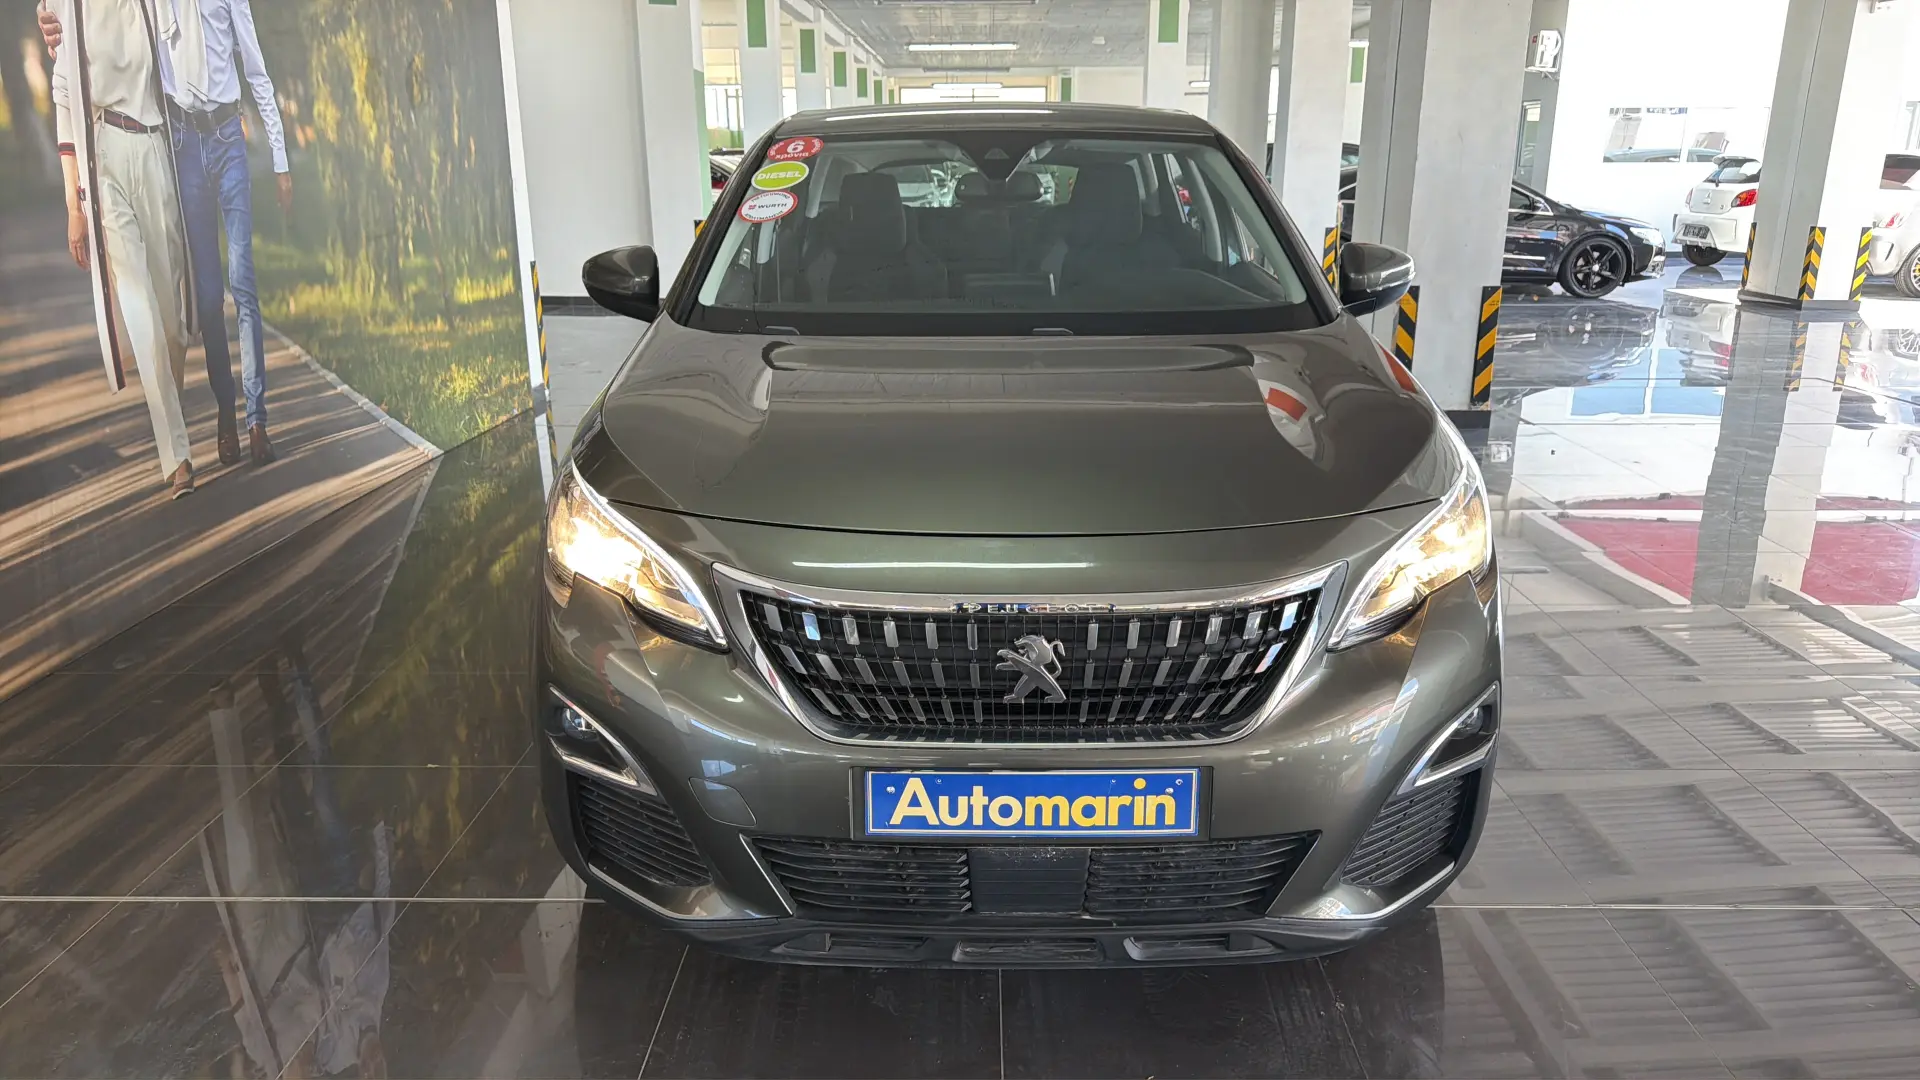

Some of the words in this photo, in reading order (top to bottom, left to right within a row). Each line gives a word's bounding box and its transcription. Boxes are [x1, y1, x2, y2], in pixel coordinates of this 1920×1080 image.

[787, 141, 805, 153] 6
[757, 171, 801, 180] DIESEL
[967, 603, 1100, 613] PEUGEOT
[889, 777, 1176, 827] Automarin
